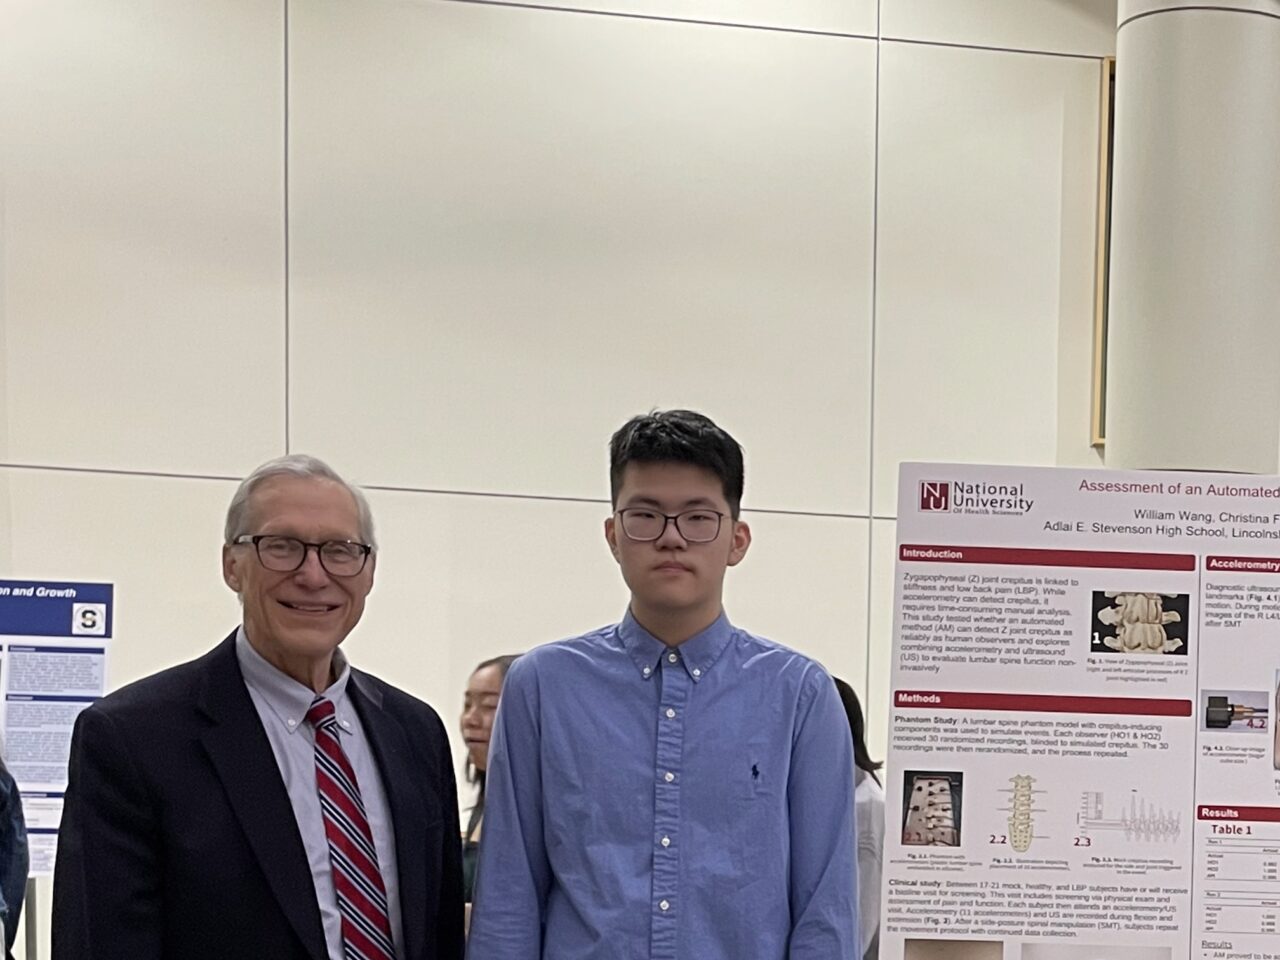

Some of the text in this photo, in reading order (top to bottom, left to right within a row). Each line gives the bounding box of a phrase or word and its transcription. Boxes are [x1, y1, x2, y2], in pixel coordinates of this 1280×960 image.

[954, 482, 1023, 496] National
[1079, 480, 1163, 493] Assessment
[1167, 482, 1181, 494] of
[1184, 486, 1202, 495] an
[1205, 484, 1280, 497] Automated
[954, 494, 1034, 512] University
[1134, 509, 1175, 520] William
[1179, 510, 1216, 523] Wang,
[1219, 512, 1269, 523] Christina
[1044, 520, 1072, 531] Adlai
[1092, 522, 1152, 533] Stevenson
[1155, 524, 1181, 537] High
[1185, 526, 1227, 538] School,
[903, 548, 962, 558] Introduction
[1210, 559, 1280, 571] Accelerometry
[12, 587, 34, 596] and
[36, 587, 76, 598] Growth
[1092, 633, 1100, 644] 1
[898, 693, 941, 703] Methods
[1247, 719, 1266, 729] 4.2
[1202, 808, 1238, 817] Results
[1212, 824, 1251, 834] Table 1
[990, 835, 1007, 844] 2.2
[1074, 837, 1091, 847] 2.3
[1201, 940, 1232, 949] Results
